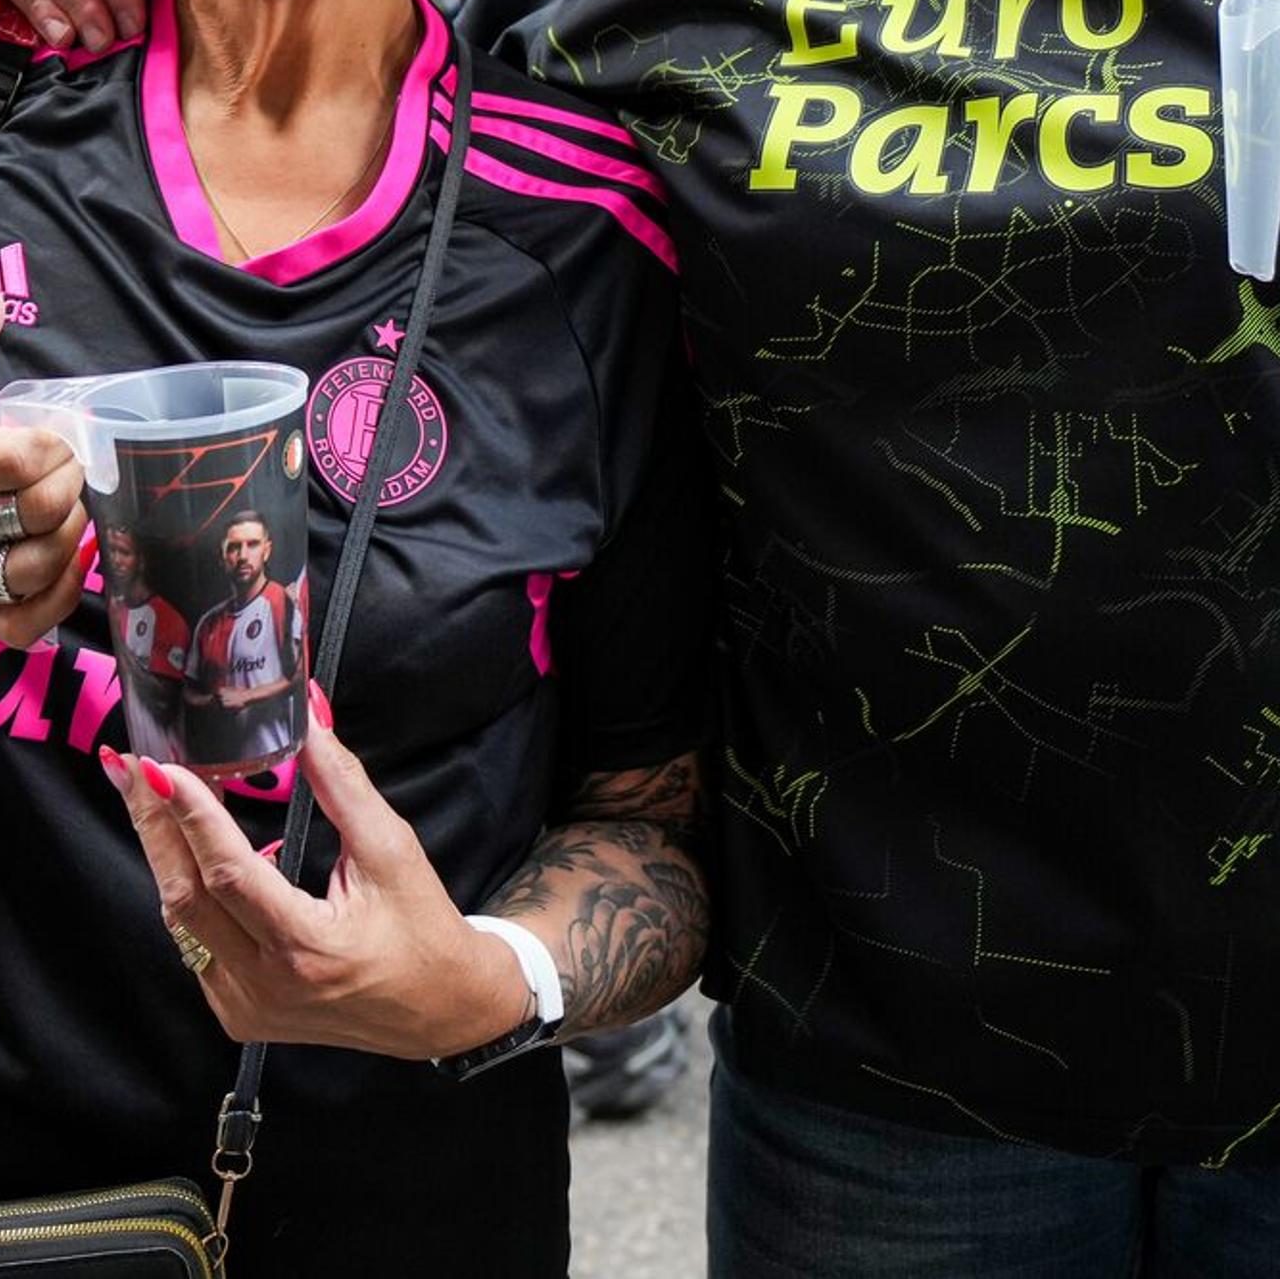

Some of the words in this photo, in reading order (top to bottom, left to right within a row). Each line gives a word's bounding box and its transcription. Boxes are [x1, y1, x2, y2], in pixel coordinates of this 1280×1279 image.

[748, 82, 1216, 195] Parcs
[321, 363, 438, 421] FEYENRD
[315, 438, 433, 500] ROTTDAM
